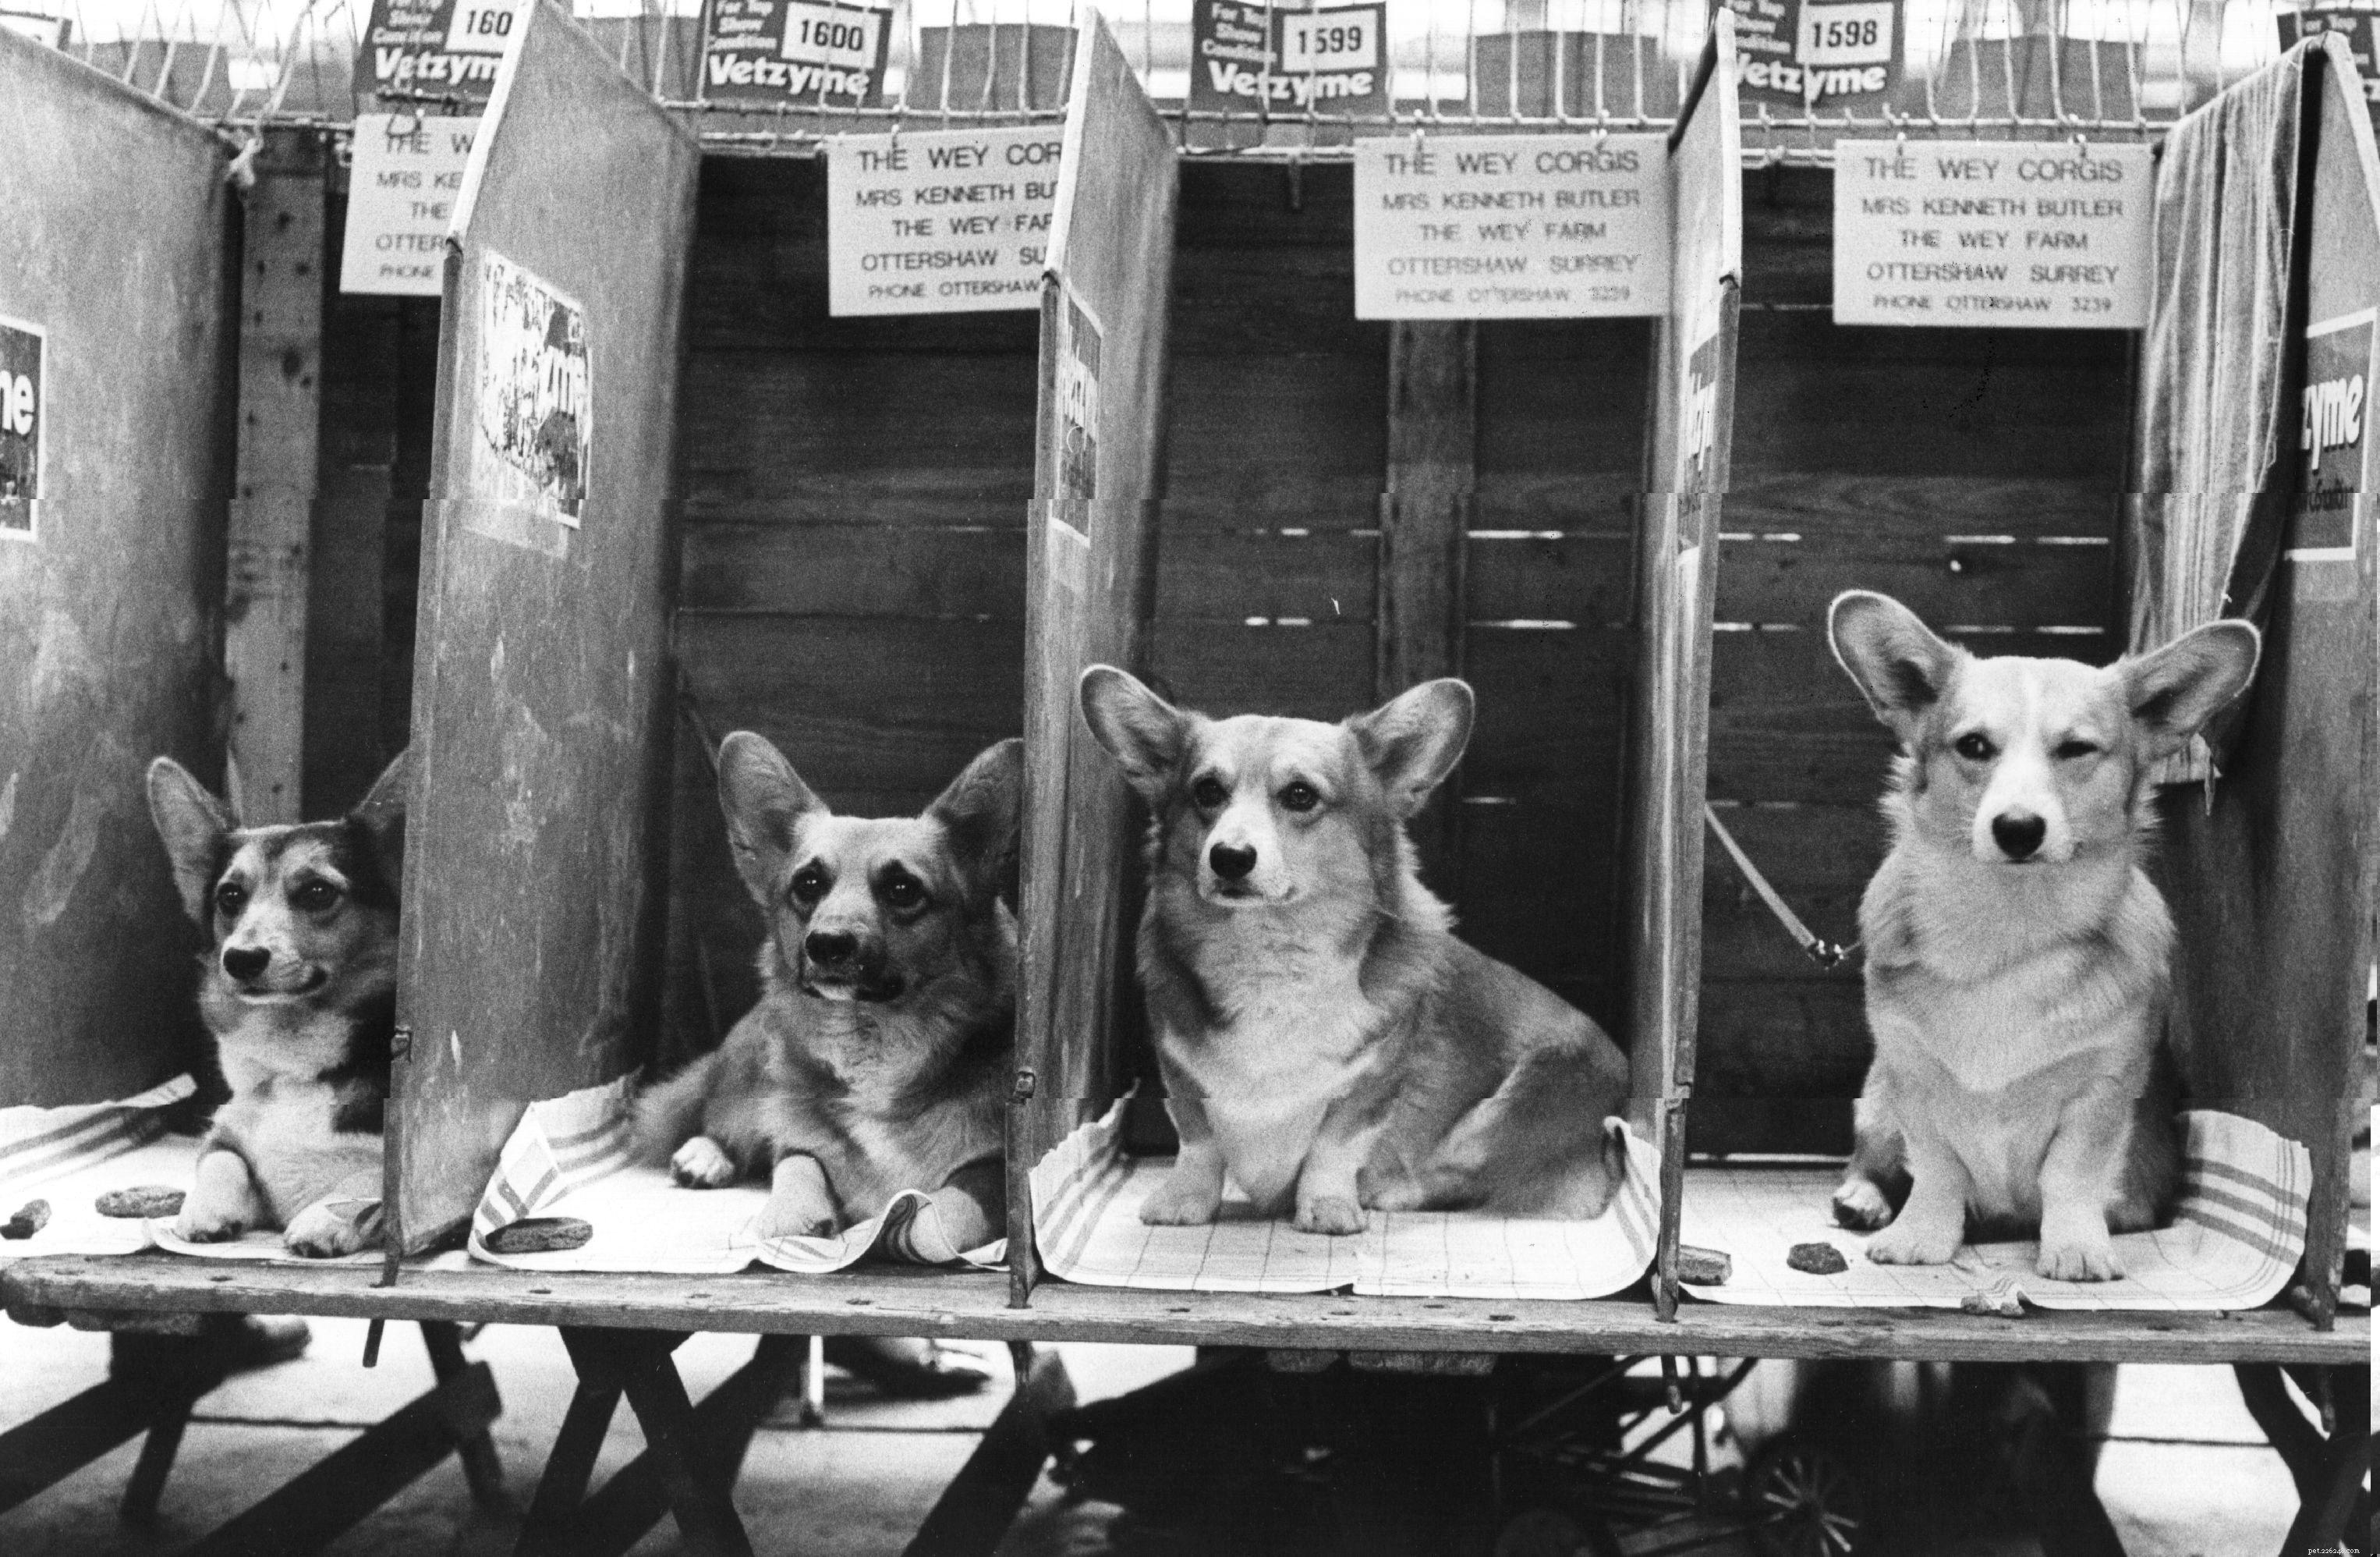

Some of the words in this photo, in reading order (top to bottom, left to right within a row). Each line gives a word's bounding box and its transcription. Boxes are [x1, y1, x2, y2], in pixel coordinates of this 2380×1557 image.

[466, 10, 513, 36] 160
[1813, 20, 1878, 48] 1598
[802, 19, 863, 51] 1600
[1298, 26, 1362, 55] 1599
[375, 47, 503, 85] Vetzym
[709, 53, 869, 95] Vetzyme
[1209, 60, 1374, 105] Vetzyme
[857, 150, 908, 171] THE
[928, 145, 988, 168] WEY
[1006, 143, 1061, 165] COR
[1383, 152, 1436, 175] THE
[1455, 151, 1518, 175] WEY
[1535, 150, 1640, 174] CORGIS
[1865, 157, 1917, 180] THE
[1938, 158, 1999, 180] WEY
[2017, 158, 2123, 182] CORGIS
[856, 189, 902, 206] MRS
[915, 183, 1015, 204] KENNETH
[1382, 193, 1429, 210] MRS
[1443, 190, 1545, 210] KENNETH
[1556, 188, 1640, 209] BUTLER
[1861, 197, 1910, 215] MRS
[1922, 197, 2026, 216] KENNETH
[2036, 197, 2123, 218] BUTLER
[892, 218, 933, 236] THE
[949, 215, 999, 234] WEY
[1420, 222, 1461, 241] THE
[1478, 222, 1529, 242] WEY
[1544, 221, 1606, 241] FARM
[376, 234, 445, 252] OTTER
[1901, 229, 1942, 248] THE
[1957, 229, 2010, 248] WEY
[2024, 229, 2088, 249] FARM
[861, 249, 998, 271] OTTERSHAW
[1387, 256, 1528, 275] OTTERSHAW
[1549, 254, 1638, 274] SURREY
[1866, 261, 2009, 282] OTTERSHAW
[2030, 264, 2120, 284] SURREY
[868, 283, 927, 298] PHONE
[938, 278, 1042, 296] OTTERSHAW
[1395, 287, 1454, 303] PHONE
[1873, 294, 1932, 310] PHONE
[1945, 294, 2051, 310] OTTERSHAW
[2301, 374, 2363, 470] zyme
